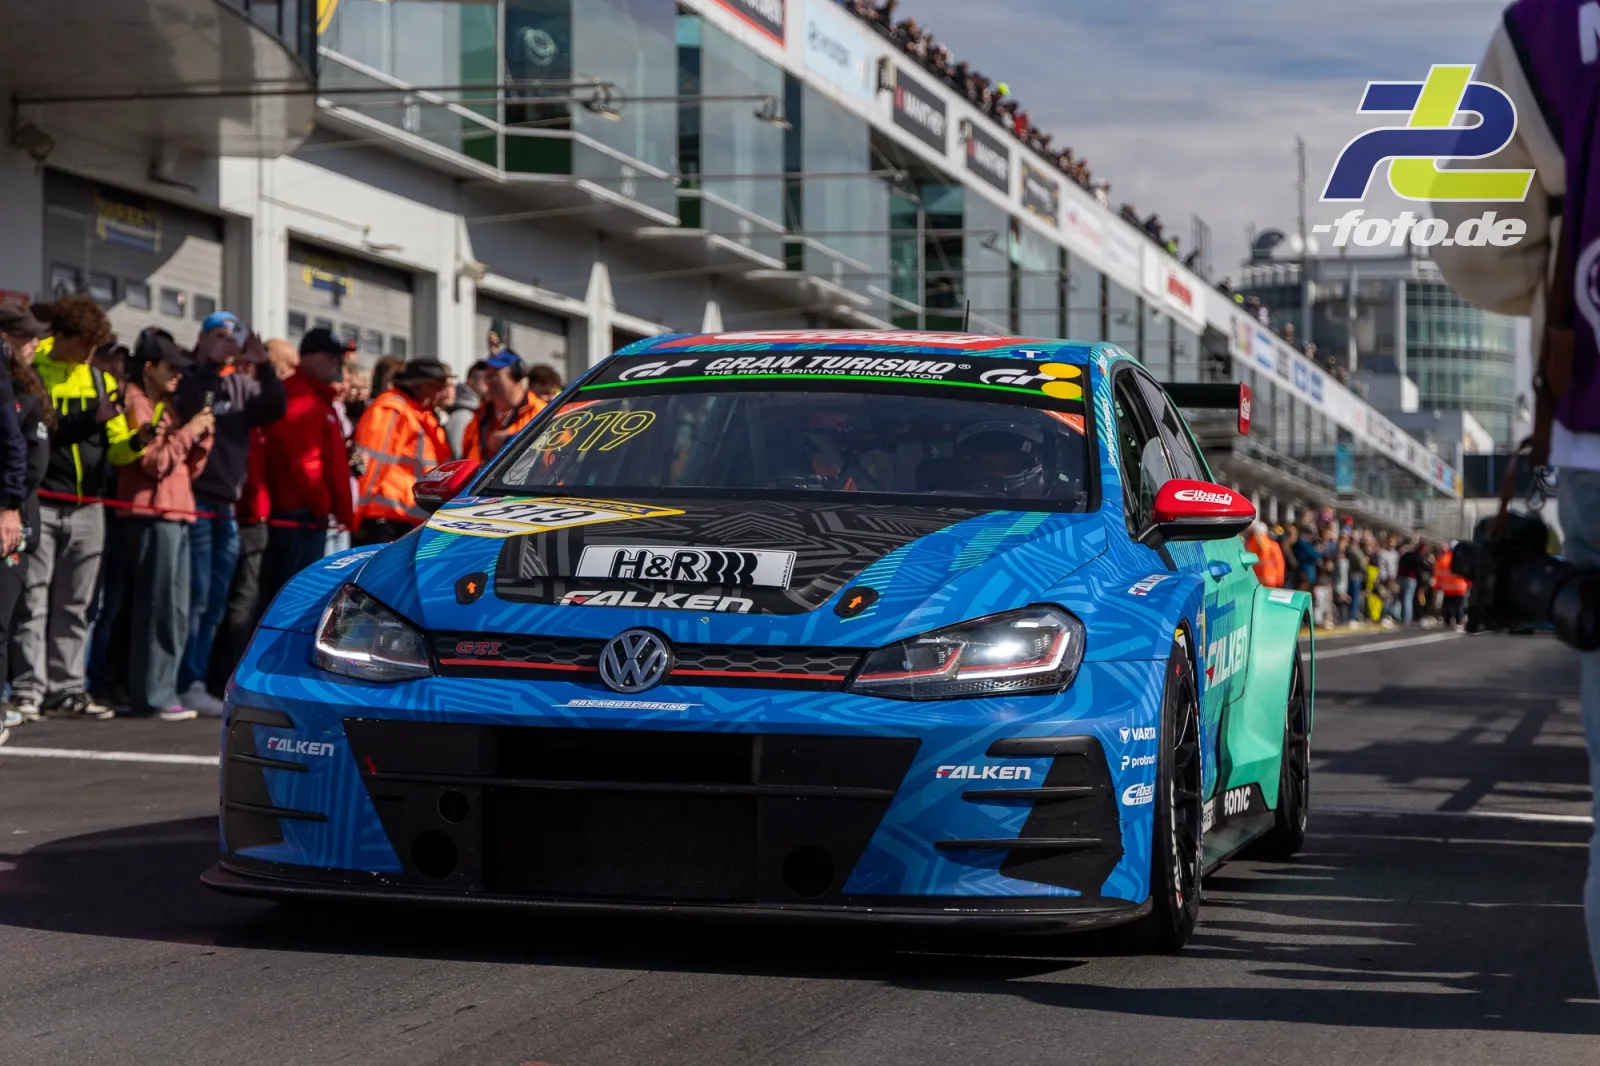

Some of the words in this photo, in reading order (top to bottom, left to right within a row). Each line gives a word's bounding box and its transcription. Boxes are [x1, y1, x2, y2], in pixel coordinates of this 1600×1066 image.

[705, 356, 803, 371] GRAN
[849, 369, 944, 380] SIMULATOR
[532, 410, 656, 452] 819
[1174, 489, 1233, 506] Eibach
[472, 504, 596, 523] 819
[559, 590, 753, 614] FALKEN
[456, 641, 502, 655] GTI
[1131, 727, 1156, 741] VARTA
[267, 736, 334, 757] FALKEN
[934, 765, 1031, 780] FALKEN
